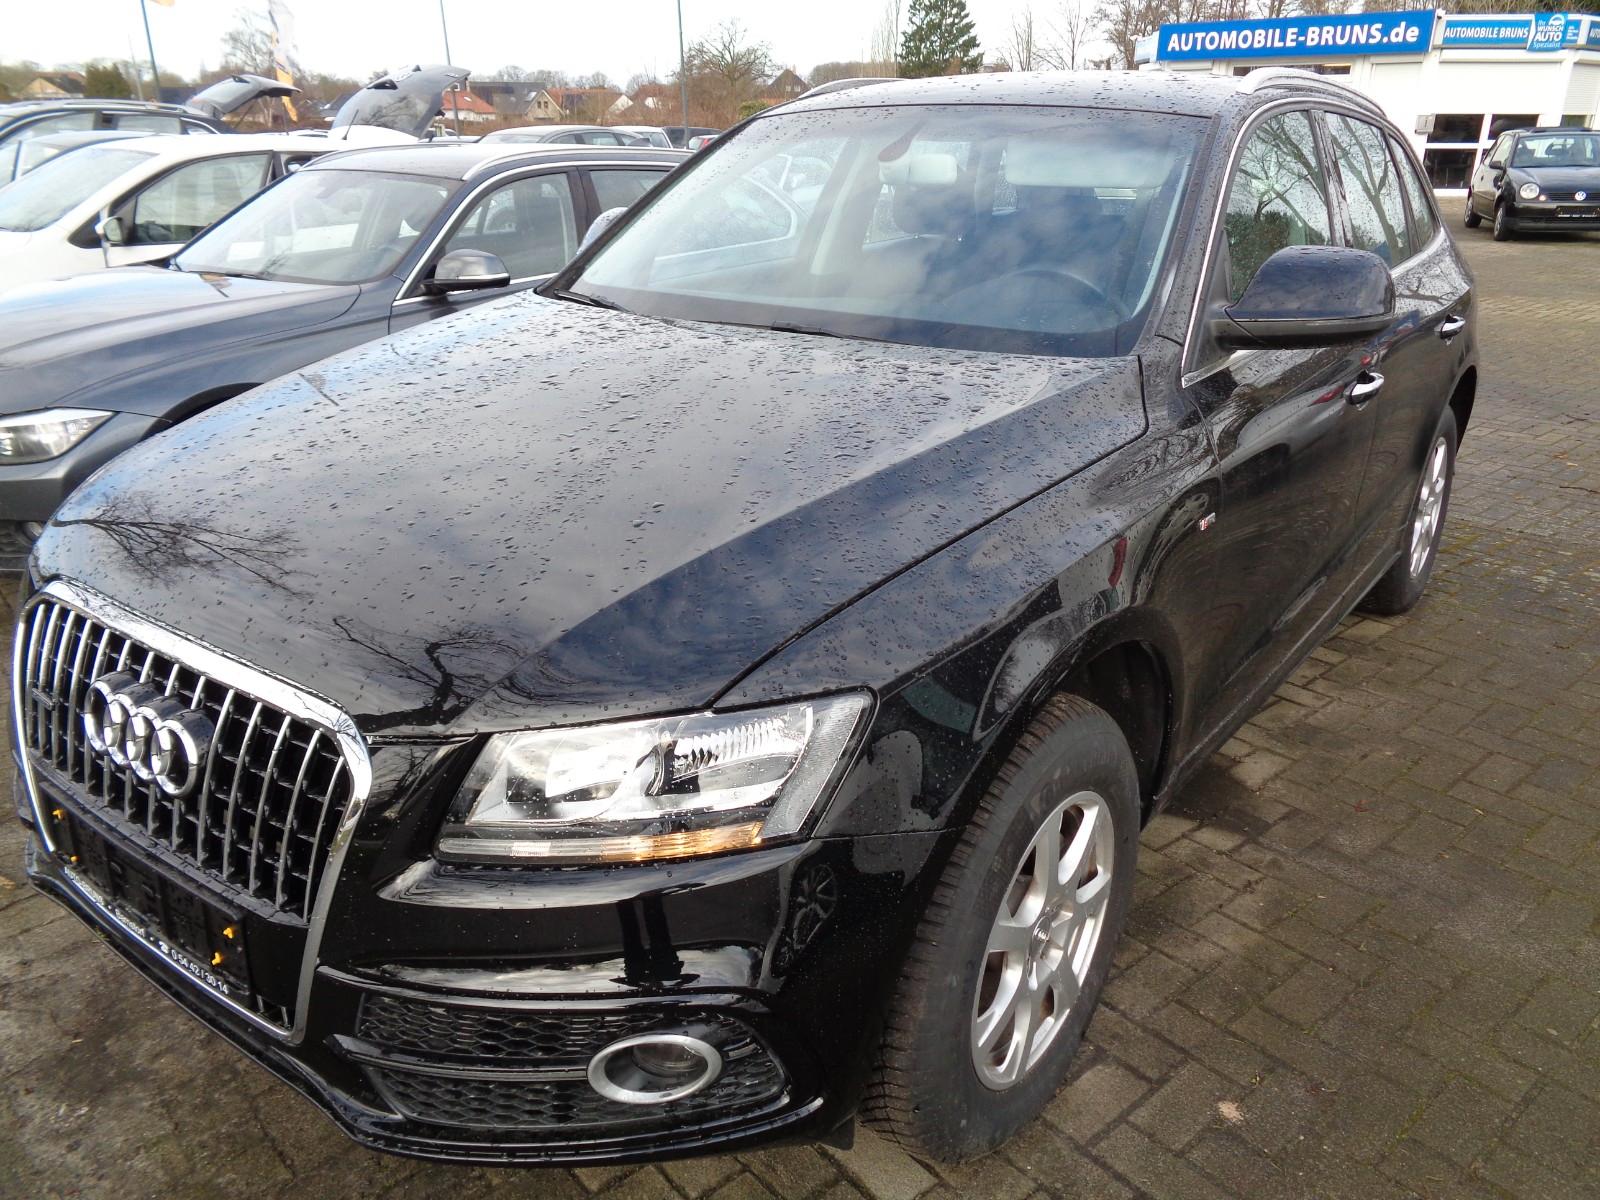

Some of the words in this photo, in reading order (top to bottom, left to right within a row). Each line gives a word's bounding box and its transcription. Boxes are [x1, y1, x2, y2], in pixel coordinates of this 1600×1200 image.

[1444, 27, 1498, 39] AUTOMOBILE
[1500, 27, 1529, 38] BRUNS
[1537, 24, 1564, 32] WUNSCH
[1167, 21, 1420, 51] AUTOMOBILE-BRUNS.de
[1534, 32, 1563, 42] AUTO
